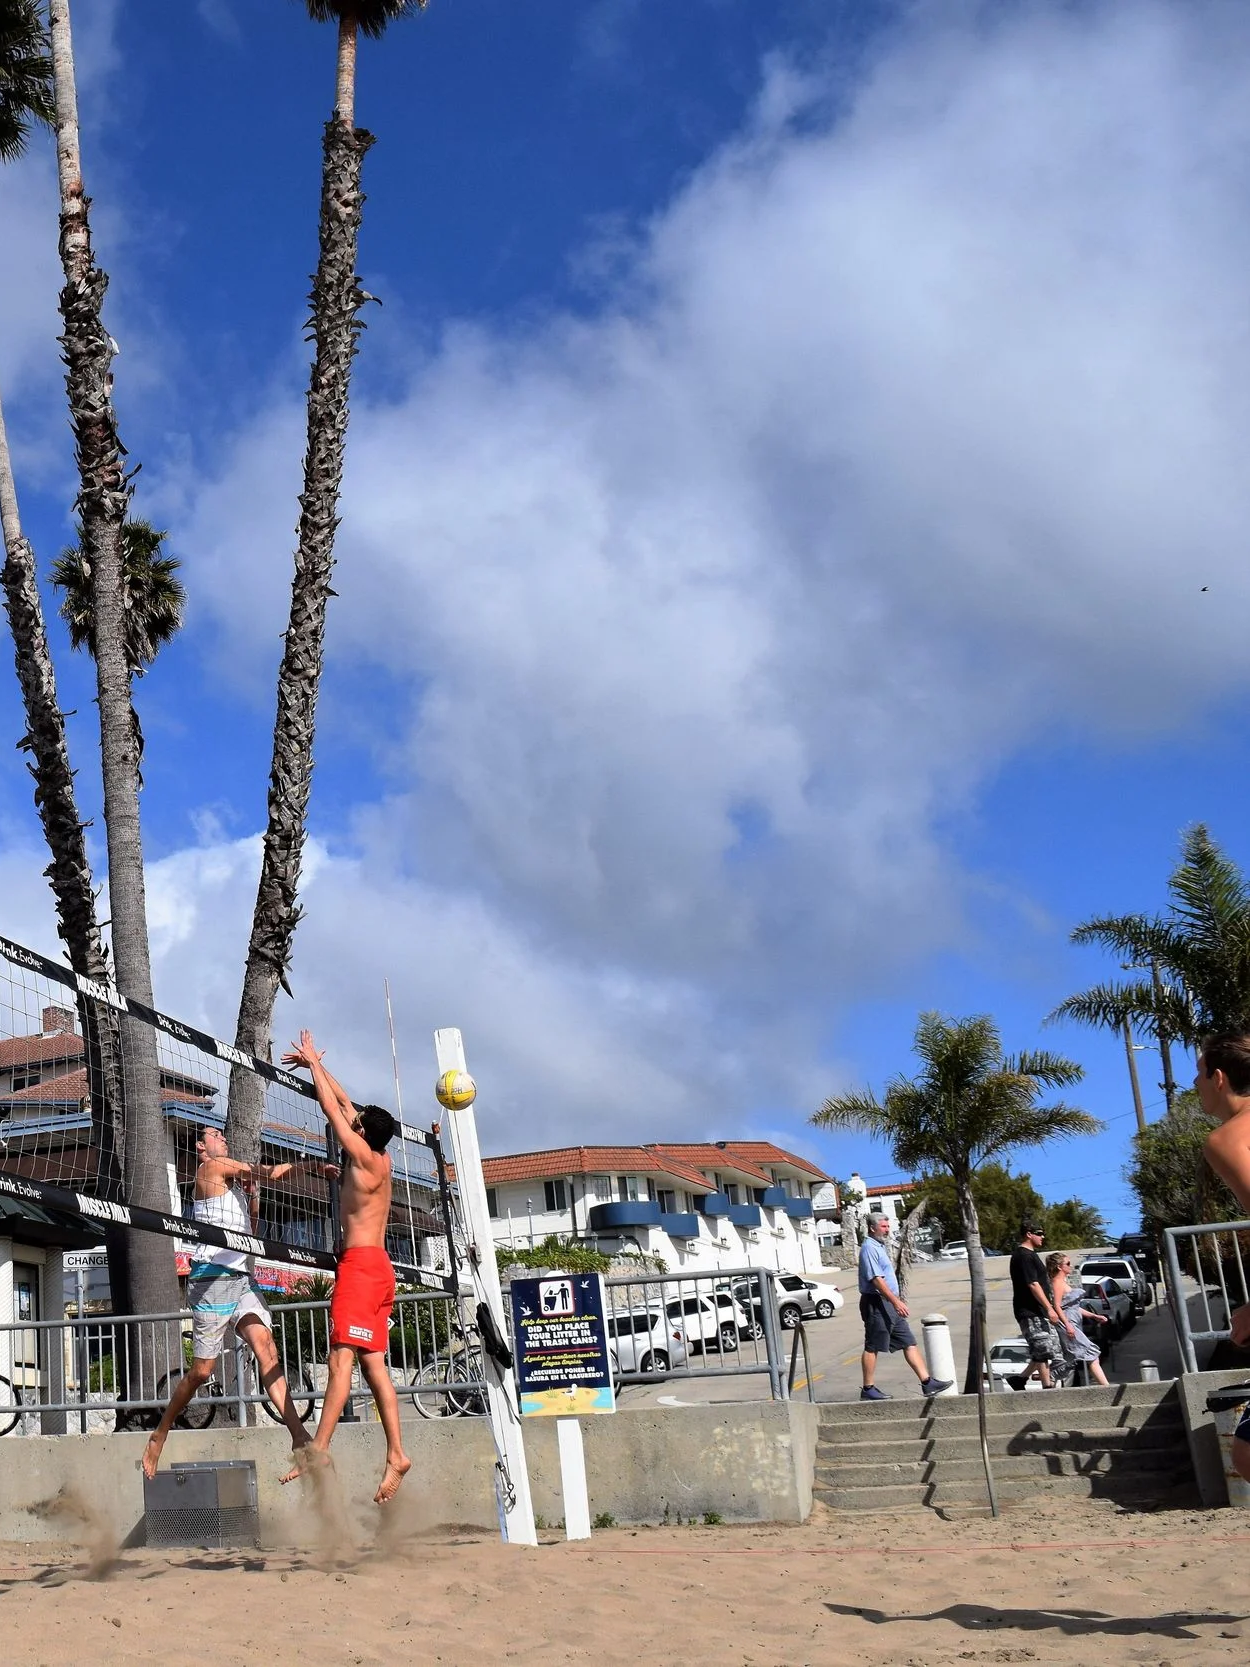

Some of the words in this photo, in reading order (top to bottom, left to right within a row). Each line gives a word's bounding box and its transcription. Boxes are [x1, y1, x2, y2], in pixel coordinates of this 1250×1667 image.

[75, 1192, 112, 1220] MUSCLE
[108, 1202, 132, 1225] MILK
[545, 1324, 563, 1332] YOU
[564, 1322, 590, 1330] PLACE
[527, 1332, 551, 1341] YOUR
[552, 1330, 579, 1339] LITTER
[580, 1329, 591, 1337] IN
[525, 1340, 540, 1348] THE
[542, 1338, 569, 1347] TRASH
[571, 1336, 598, 1345] CANS?
